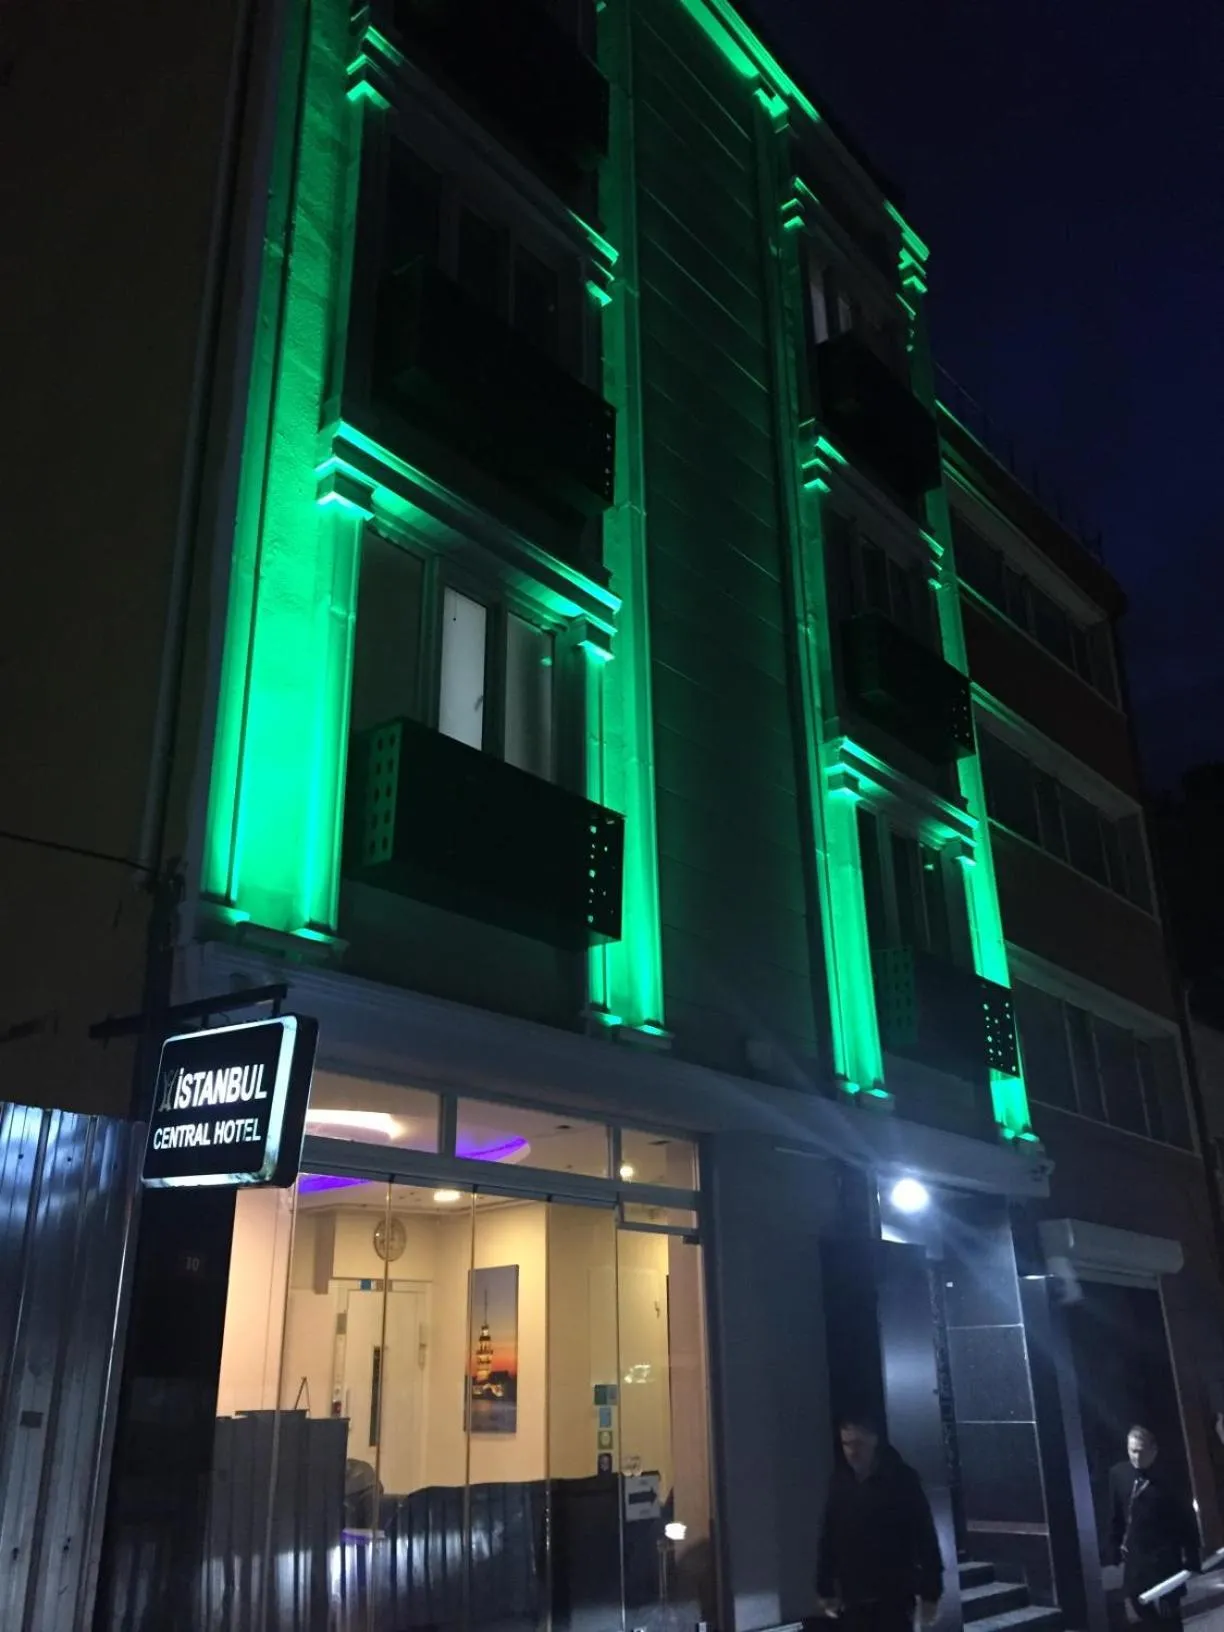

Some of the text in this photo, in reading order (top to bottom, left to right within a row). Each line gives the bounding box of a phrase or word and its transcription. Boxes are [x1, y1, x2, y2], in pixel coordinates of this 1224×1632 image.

[173, 1064, 267, 1109] İSTANBUL
[153, 1118, 261, 1150] CENTRAL HOTEL
